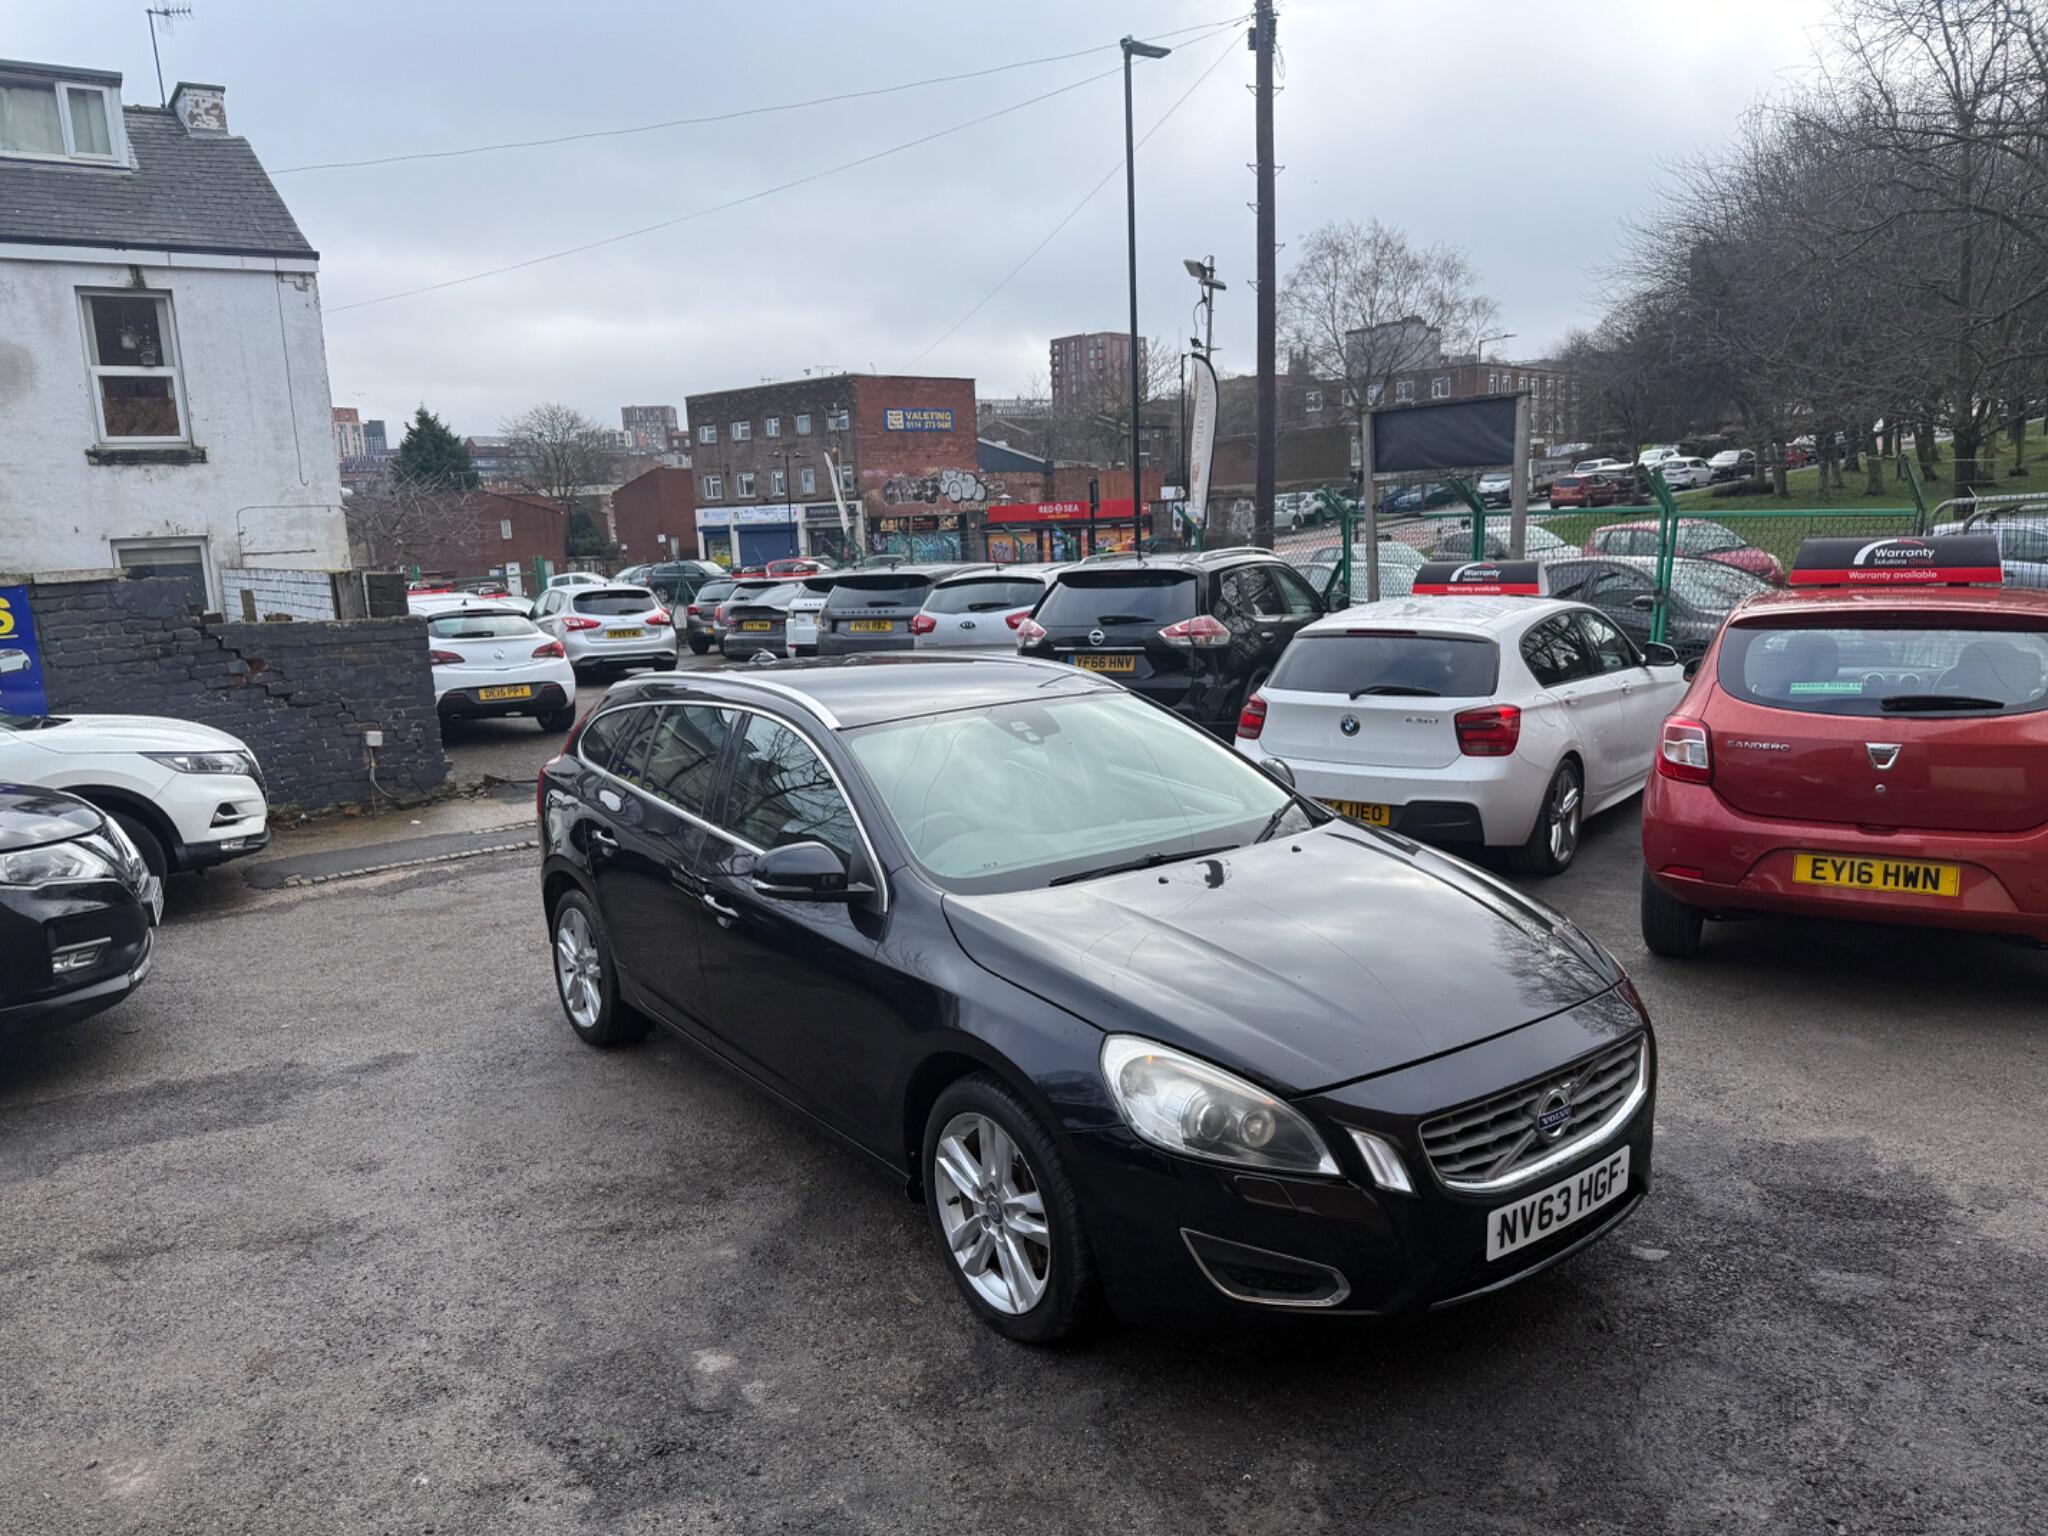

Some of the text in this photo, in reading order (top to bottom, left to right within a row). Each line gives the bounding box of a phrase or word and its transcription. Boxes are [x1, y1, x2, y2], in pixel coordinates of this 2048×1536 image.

[905, 411, 951, 420] VALETING
[1039, 503, 1079, 513] RED SEA
[1875, 548, 1935, 558] Warranty
[1463, 569, 1501, 578] Warranty
[1848, 570, 1938, 580] Warranty available
[1076, 656, 1133, 669] YF66 HNV
[1727, 740, 1792, 751] SANDERO
[1811, 858, 1941, 891] EY16 HWN
[1541, 1107, 1571, 1125] VOLVO
[1499, 1156, 1622, 1250] NV63 HGF
